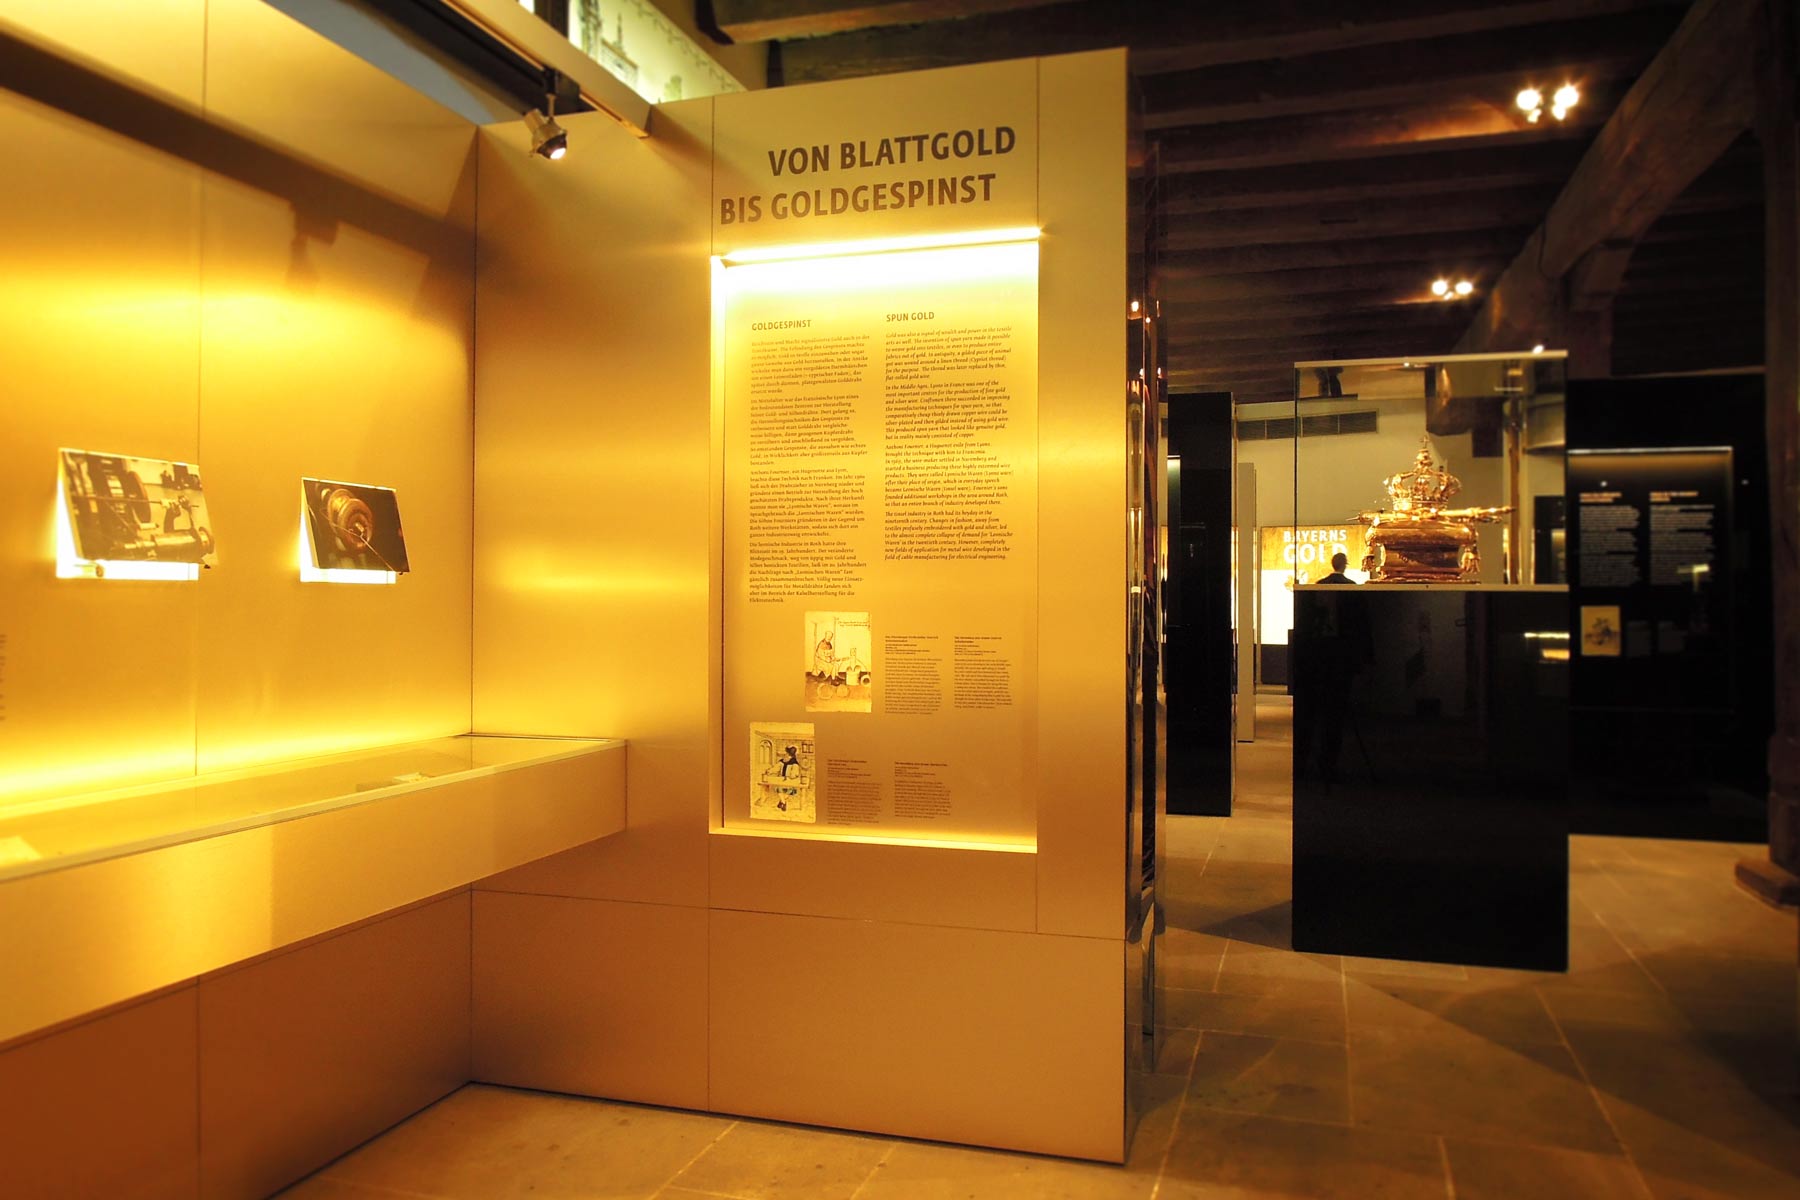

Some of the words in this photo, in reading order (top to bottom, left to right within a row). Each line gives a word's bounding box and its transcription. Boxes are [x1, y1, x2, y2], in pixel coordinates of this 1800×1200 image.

[768, 145, 830, 177] VON
[840, 126, 1016, 170] BLATTGOLD
[721, 195, 762, 224] BIS
[771, 173, 996, 220] GOLDGESPINST
[886, 313, 909, 322] SPUN
[911, 311, 935, 321] GOLD
[751, 319, 812, 331] GOLDGESPINST
[1283, 529, 1347, 543] BAYERNS
